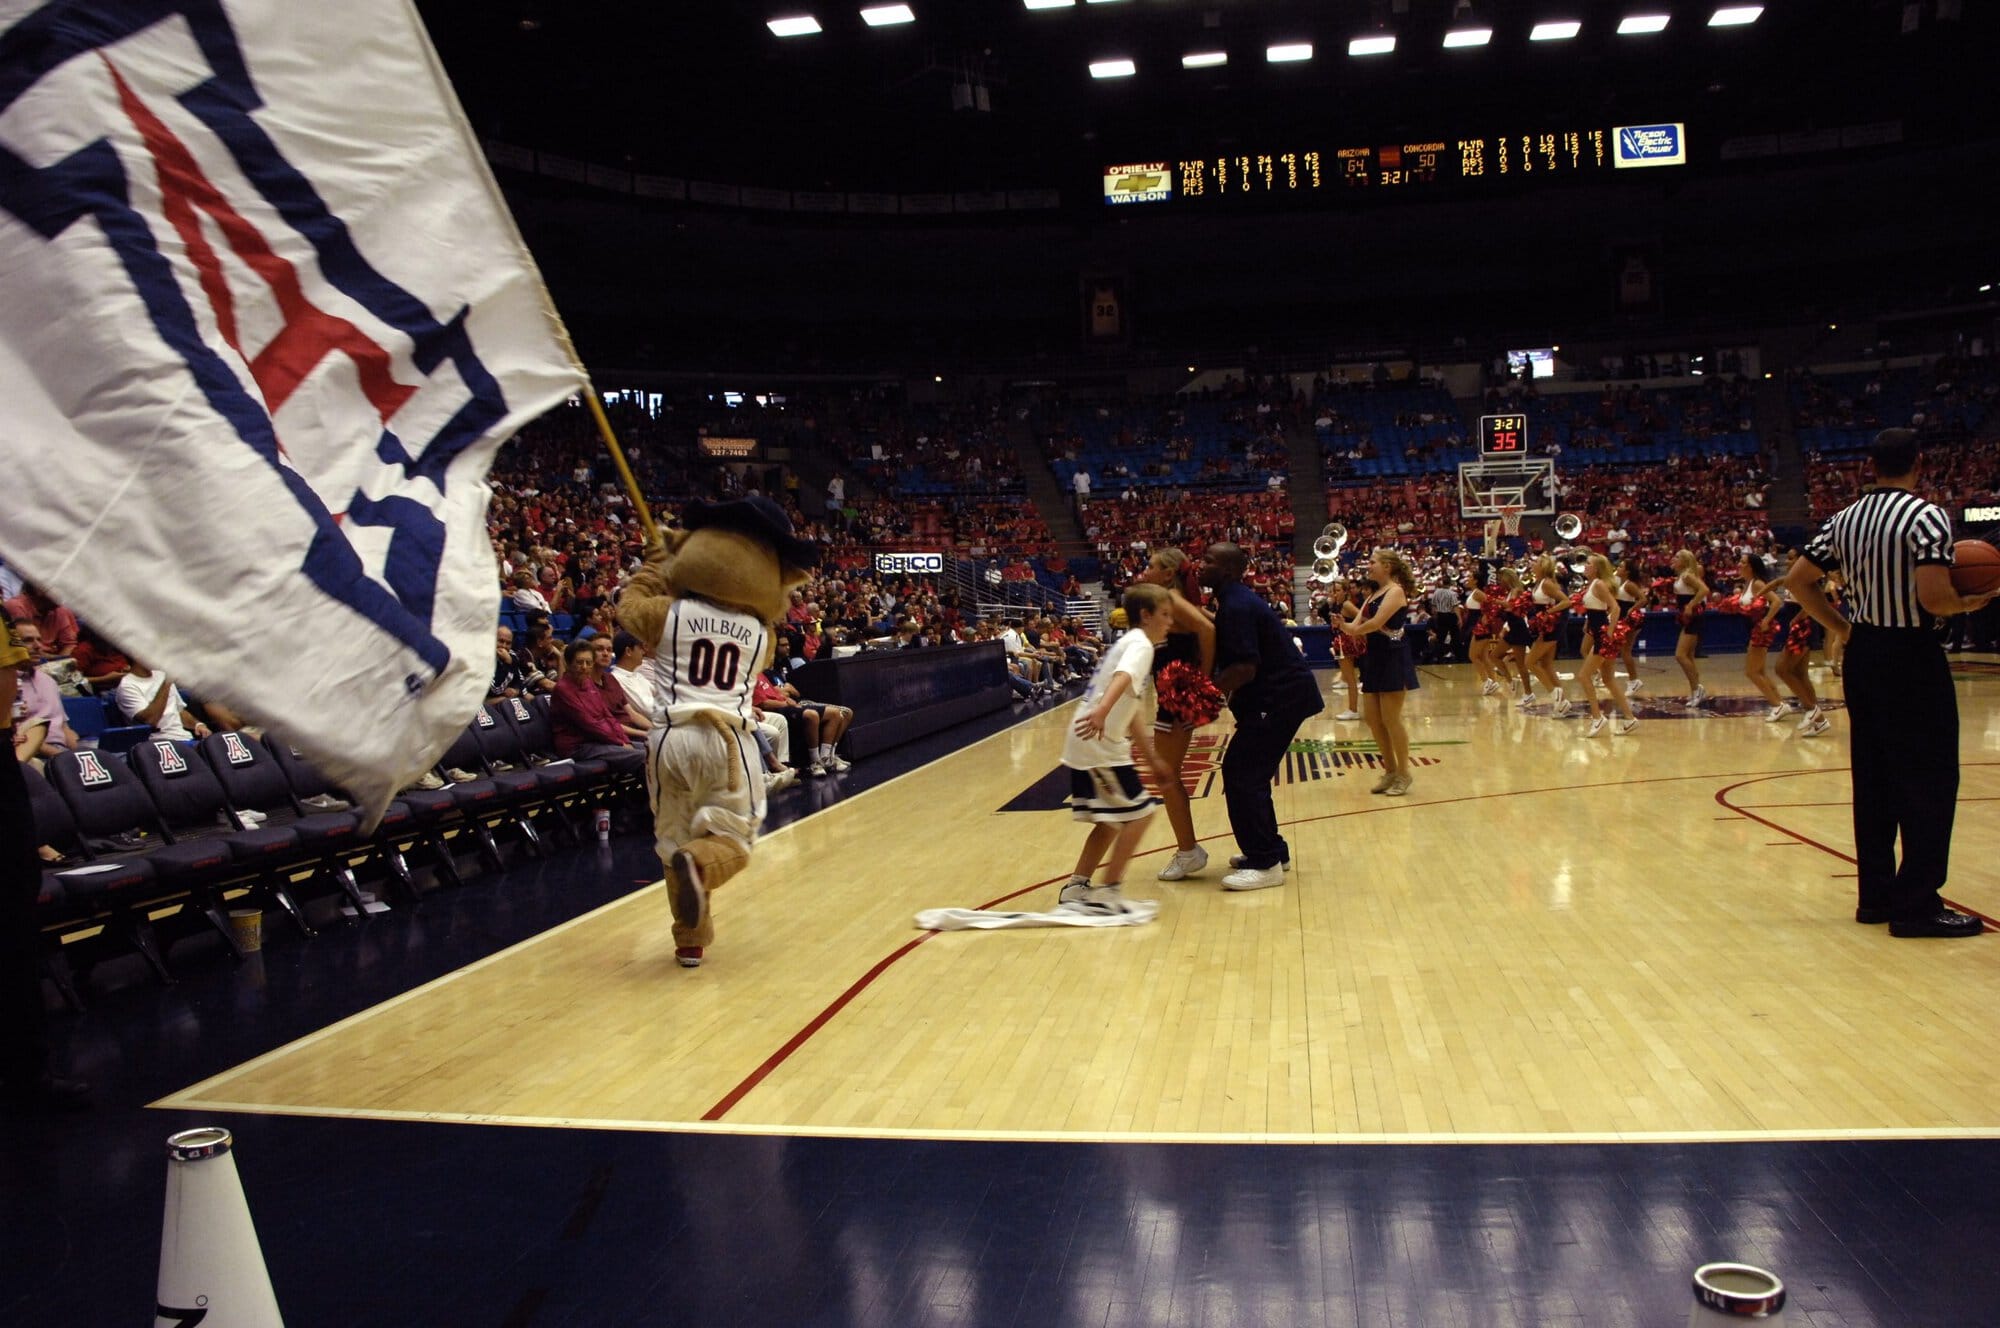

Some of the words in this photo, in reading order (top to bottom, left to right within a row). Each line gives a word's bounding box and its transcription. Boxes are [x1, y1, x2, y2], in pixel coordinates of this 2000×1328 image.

[1458, 139, 1484, 150] PLYR
[1498, 137, 1506, 147] 7
[1522, 135, 1530, 145] 9
[1540, 134, 1555, 143] 10
[1588, 130, 1603, 140] 15
[1633, 130, 1666, 140] Tucson
[1637, 137, 1673, 147] Electric
[1338, 148, 1370, 158] ARIZONA
[1403, 142, 1445, 153] CONCORDIA
[1463, 148, 1481, 158] PTS
[1499, 146, 1507, 156] 0
[1641, 145, 1674, 155] Power
[1235, 156, 1249, 166] 13
[1257, 155, 1272, 165] 34
[1280, 154, 1296, 163] 42
[1304, 152, 1319, 161] 43
[1347, 159, 1364, 173] 64
[1462, 157, 1483, 167] RBS
[1109, 162, 1164, 175] O'RIELLY
[1184, 169, 1202, 178] PTS
[1305, 160, 1320, 170] 12
[1463, 166, 1484, 176] FLS
[1524, 162, 1532, 172] 0
[1183, 177, 1203, 187] RBS
[1380, 170, 1409, 185] 3:21
[1242, 183, 1250, 191] 0
[1289, 180, 1297, 189] 0
[1111, 191, 1167, 204] WATSON
[1493, 418, 1521, 430] 3:21
[1493, 432, 1516, 450] 35
[877, 556, 942, 570] GEICO
[687, 617, 753, 646] WILBUR
[688, 638, 741, 691] 00
[222, 733, 253, 764] A
[153, 741, 188, 774] A
[74, 750, 112, 786] A
